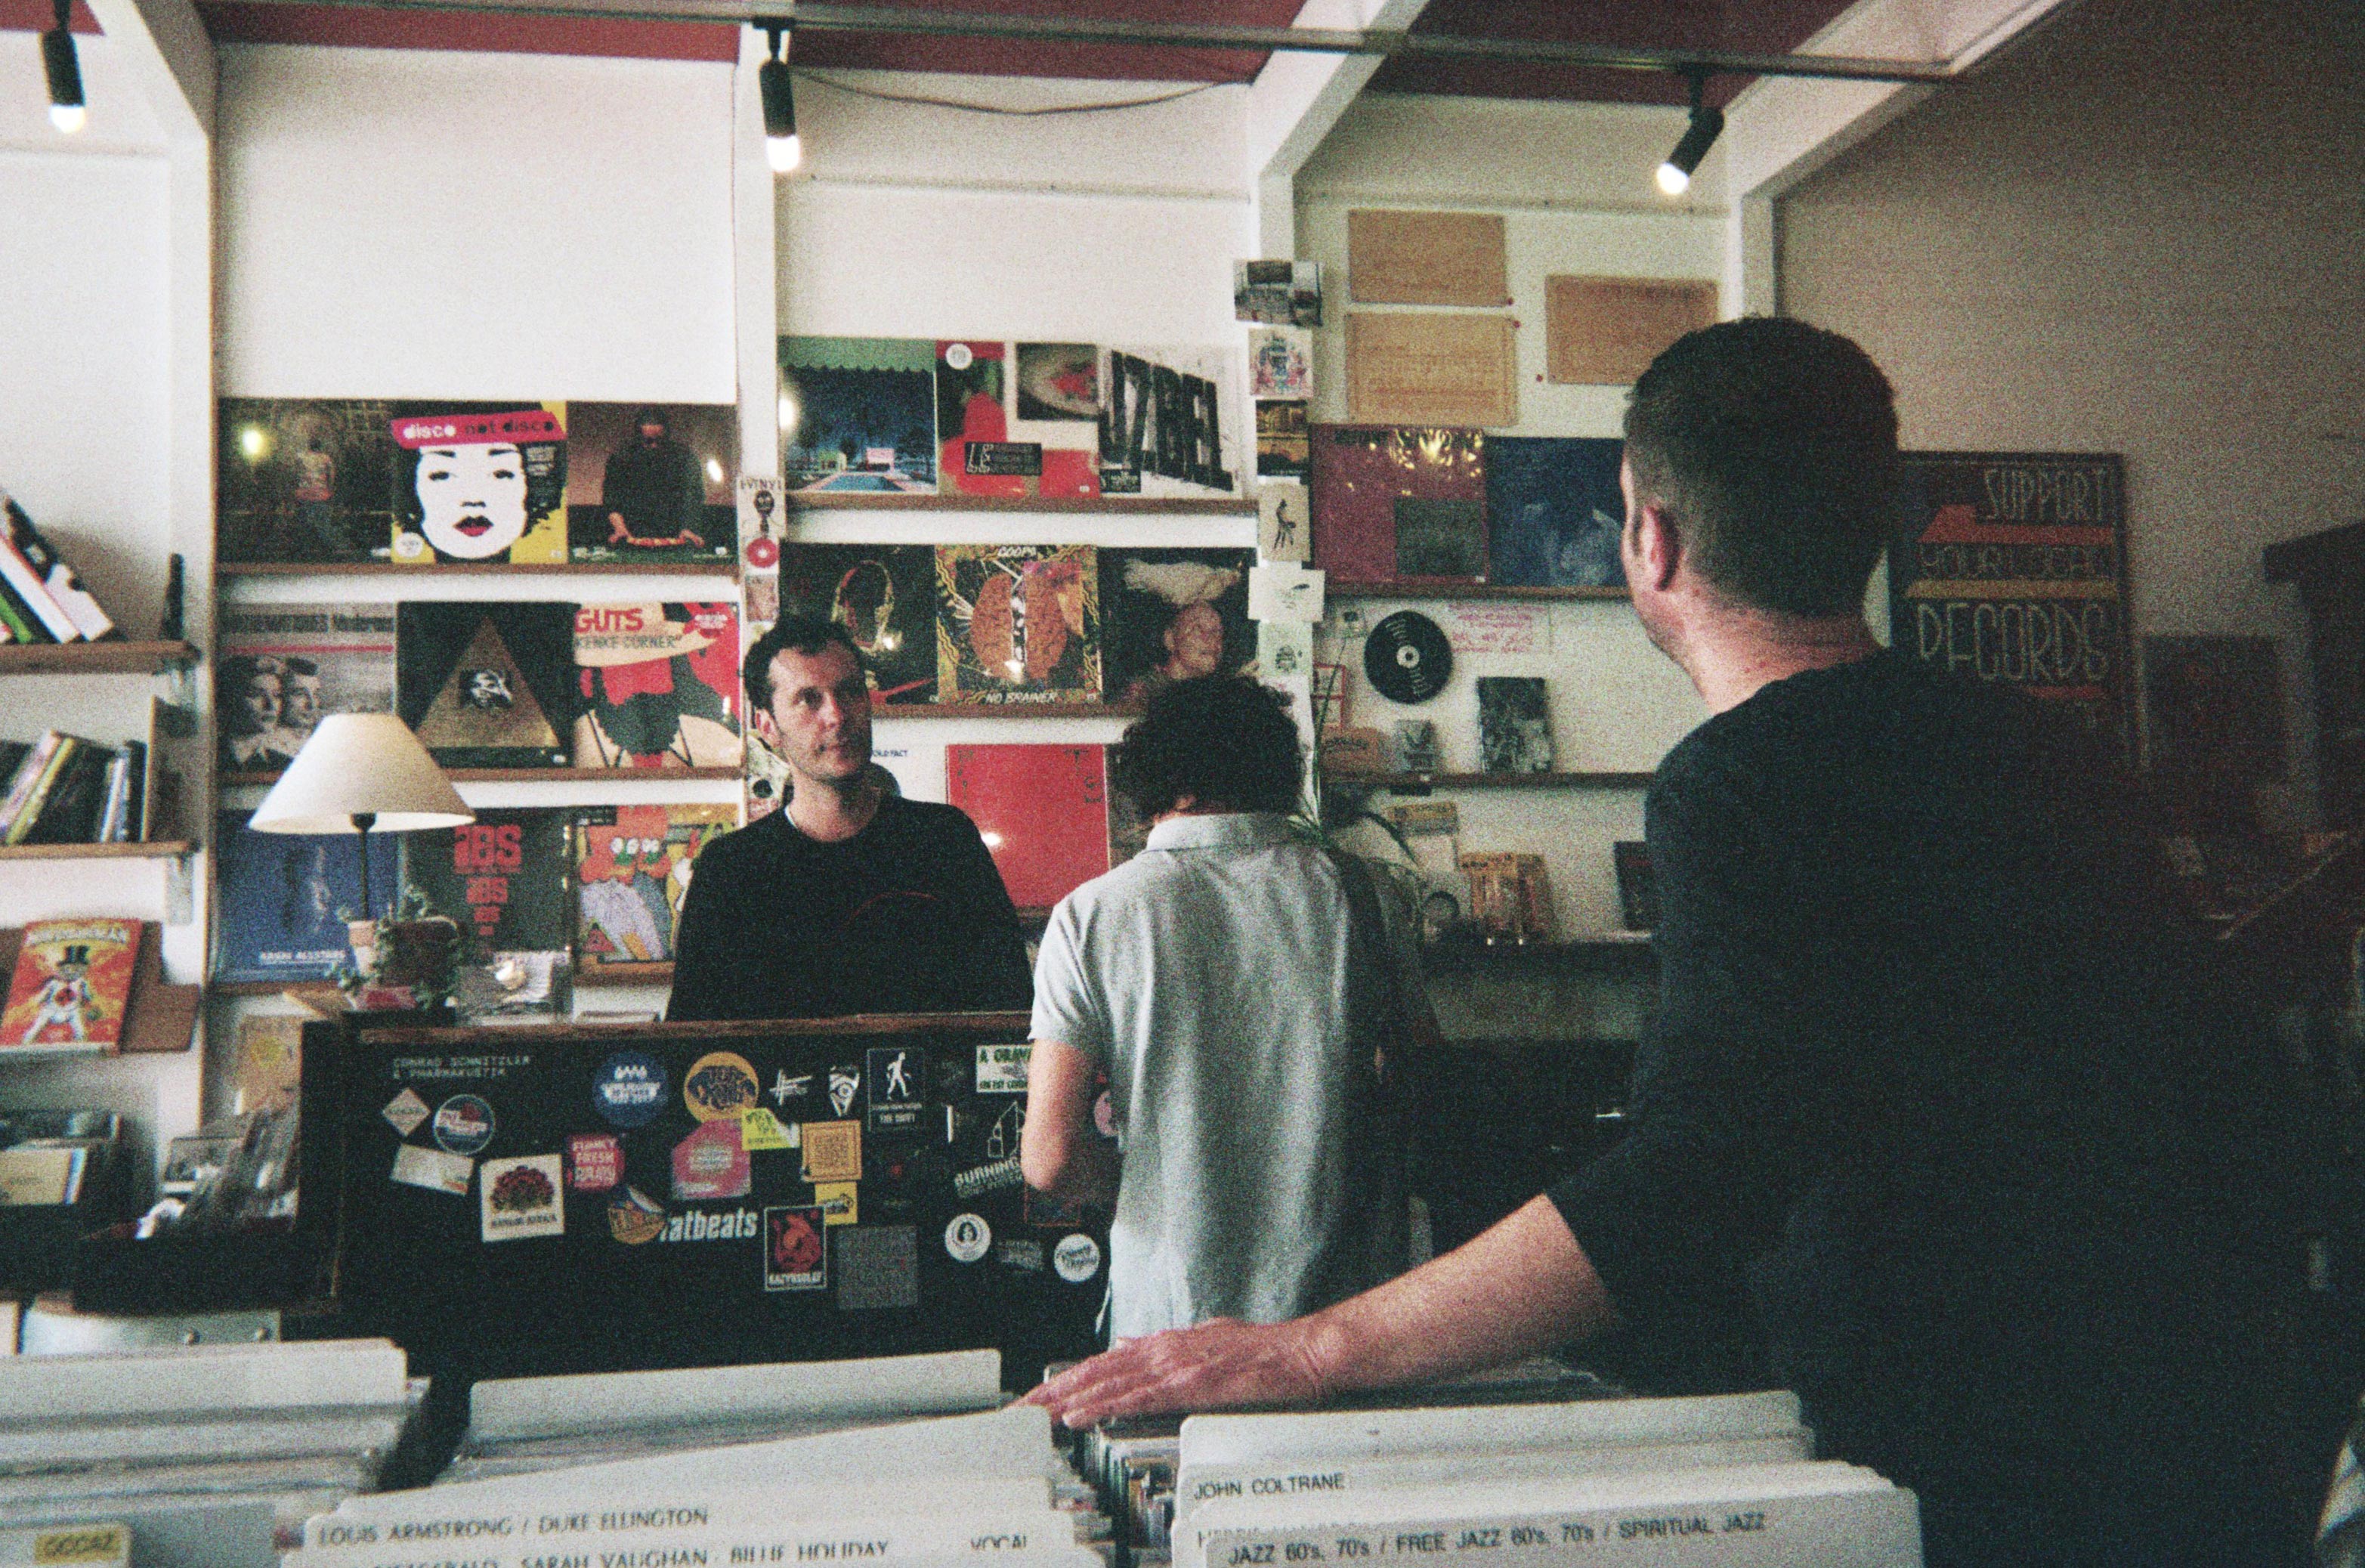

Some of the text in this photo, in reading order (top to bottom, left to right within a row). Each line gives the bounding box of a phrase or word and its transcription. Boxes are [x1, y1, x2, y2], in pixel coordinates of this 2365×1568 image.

[403, 418, 554, 439] disco not disco
[1983, 468, 2106, 521] SUPPORT
[574, 608, 644, 633] GUTS
[1917, 602, 2109, 682] RECORDS
[1194, 1471, 1346, 1500] JOHN COLTRANE
[317, 1524, 377, 1546] LOUIS
[388, 1517, 512, 1542] ARMSTRONG
[538, 1512, 590, 1534] DUKE
[599, 1509, 709, 1532] ELLINGTON
[1228, 1544, 1275, 1565] JAZZ
[1337, 1536, 1371, 1557] 70's
[1395, 1531, 1447, 1553] FREE
[1455, 1528, 1502, 1549] JAZZ
[1562, 1522, 1594, 1542] 70's
[1618, 1516, 1713, 1540] SPIRITUAL
[1722, 1511, 1765, 1532] JAZZ
[599, 1550, 709, 1568] VAUGHAN
